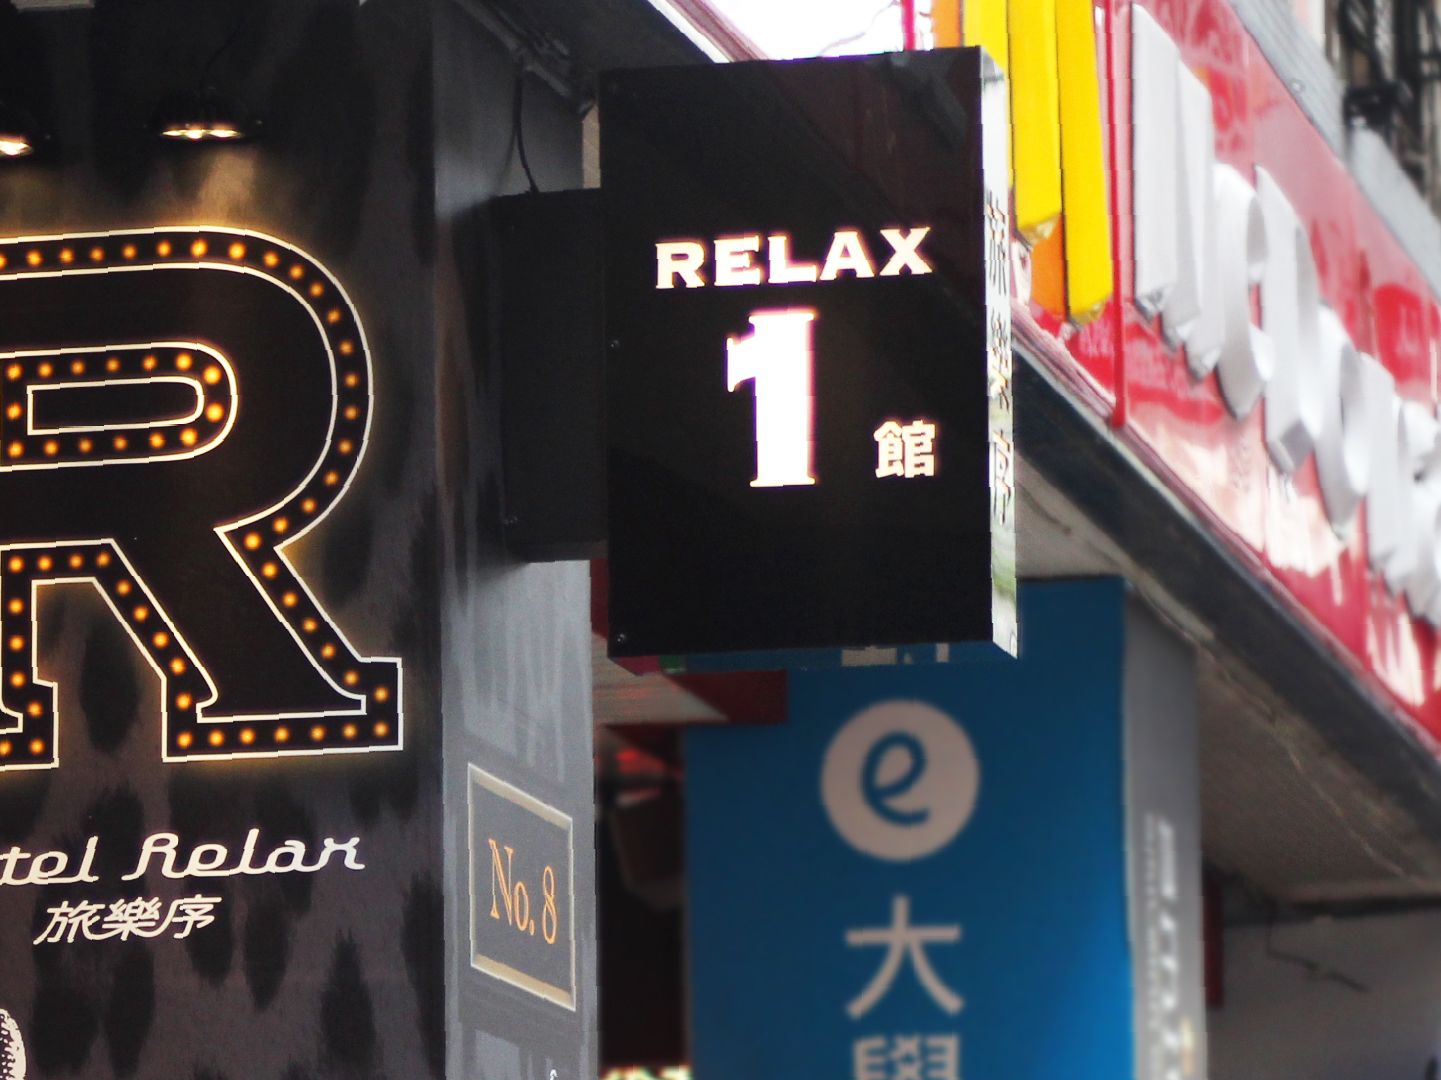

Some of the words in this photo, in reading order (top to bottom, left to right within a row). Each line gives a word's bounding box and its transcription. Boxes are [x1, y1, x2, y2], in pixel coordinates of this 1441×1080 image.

[655, 227, 933, 289] RELAX
[726, 308, 818, 488] 1
[873, 419, 938, 480] 館
[122, 828, 365, 882] Relax
[33, 896, 222, 945] 旅樂序
